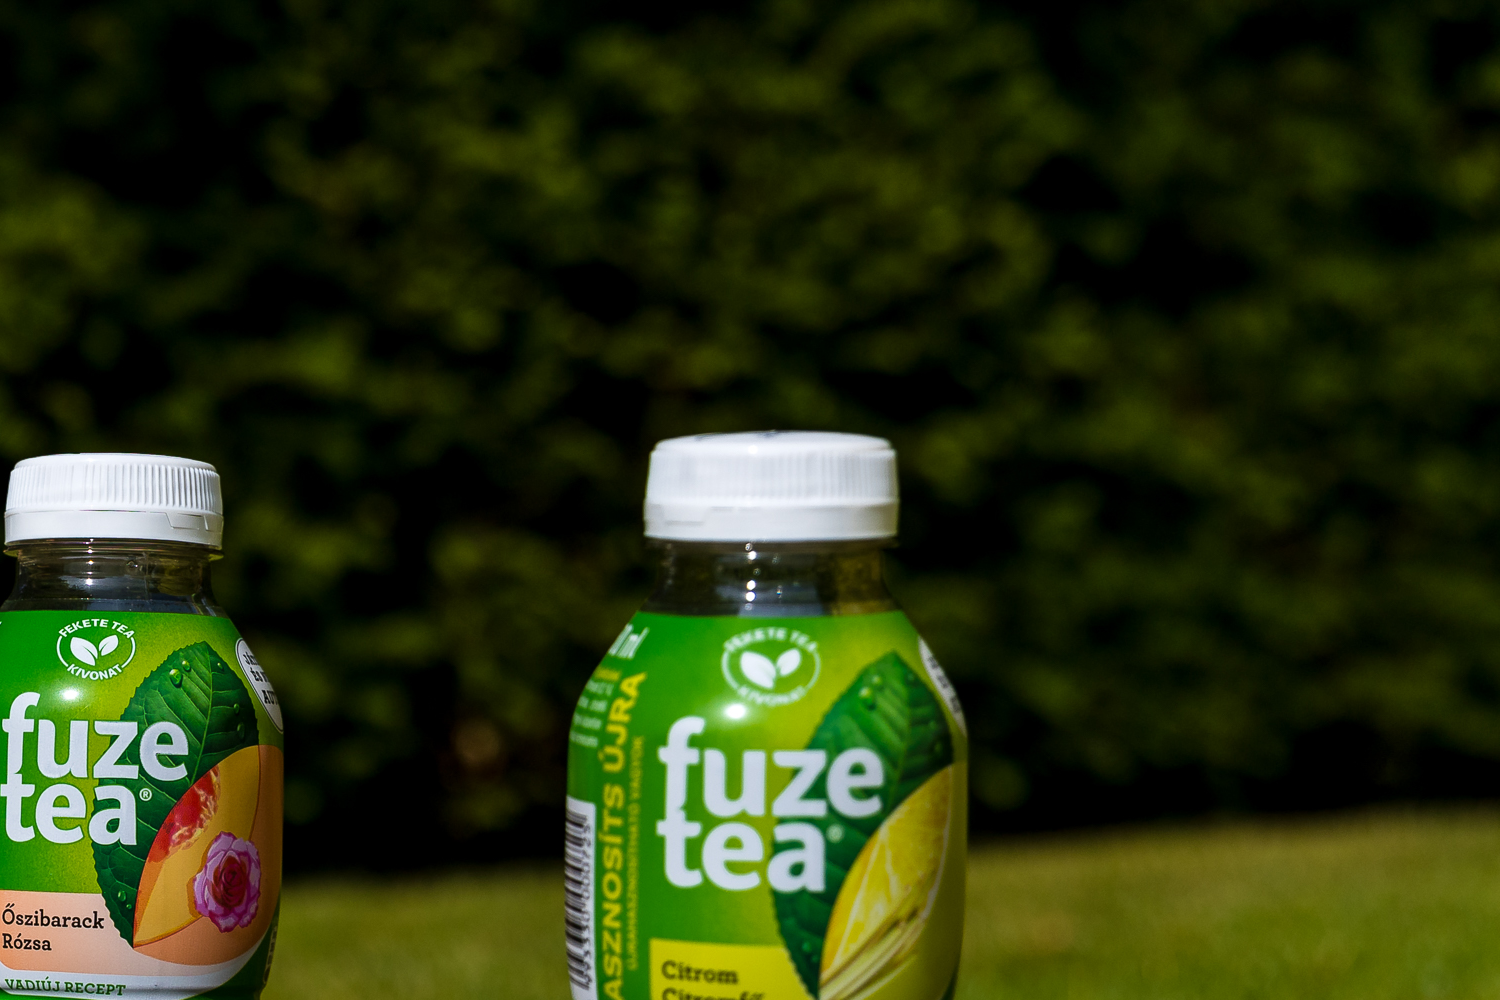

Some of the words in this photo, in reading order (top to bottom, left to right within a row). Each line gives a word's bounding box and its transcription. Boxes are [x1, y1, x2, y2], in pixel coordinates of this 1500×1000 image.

[58, 618, 109, 637] FEKETE
[111, 621, 135, 639] TEA
[67, 663, 122, 680] KIVONAT
[598, 671, 648, 773] ÚJRA
[2, 692, 189, 782] fuze
[657, 716, 885, 818] fuze
[2, 903, 104, 929] Őszibarack
[2, 933, 52, 951] Rózsa
[662, 960, 738, 985] Citrom
[5, 976, 60, 992] VADIÚJ
[64, 981, 126, 996] RECEPT
